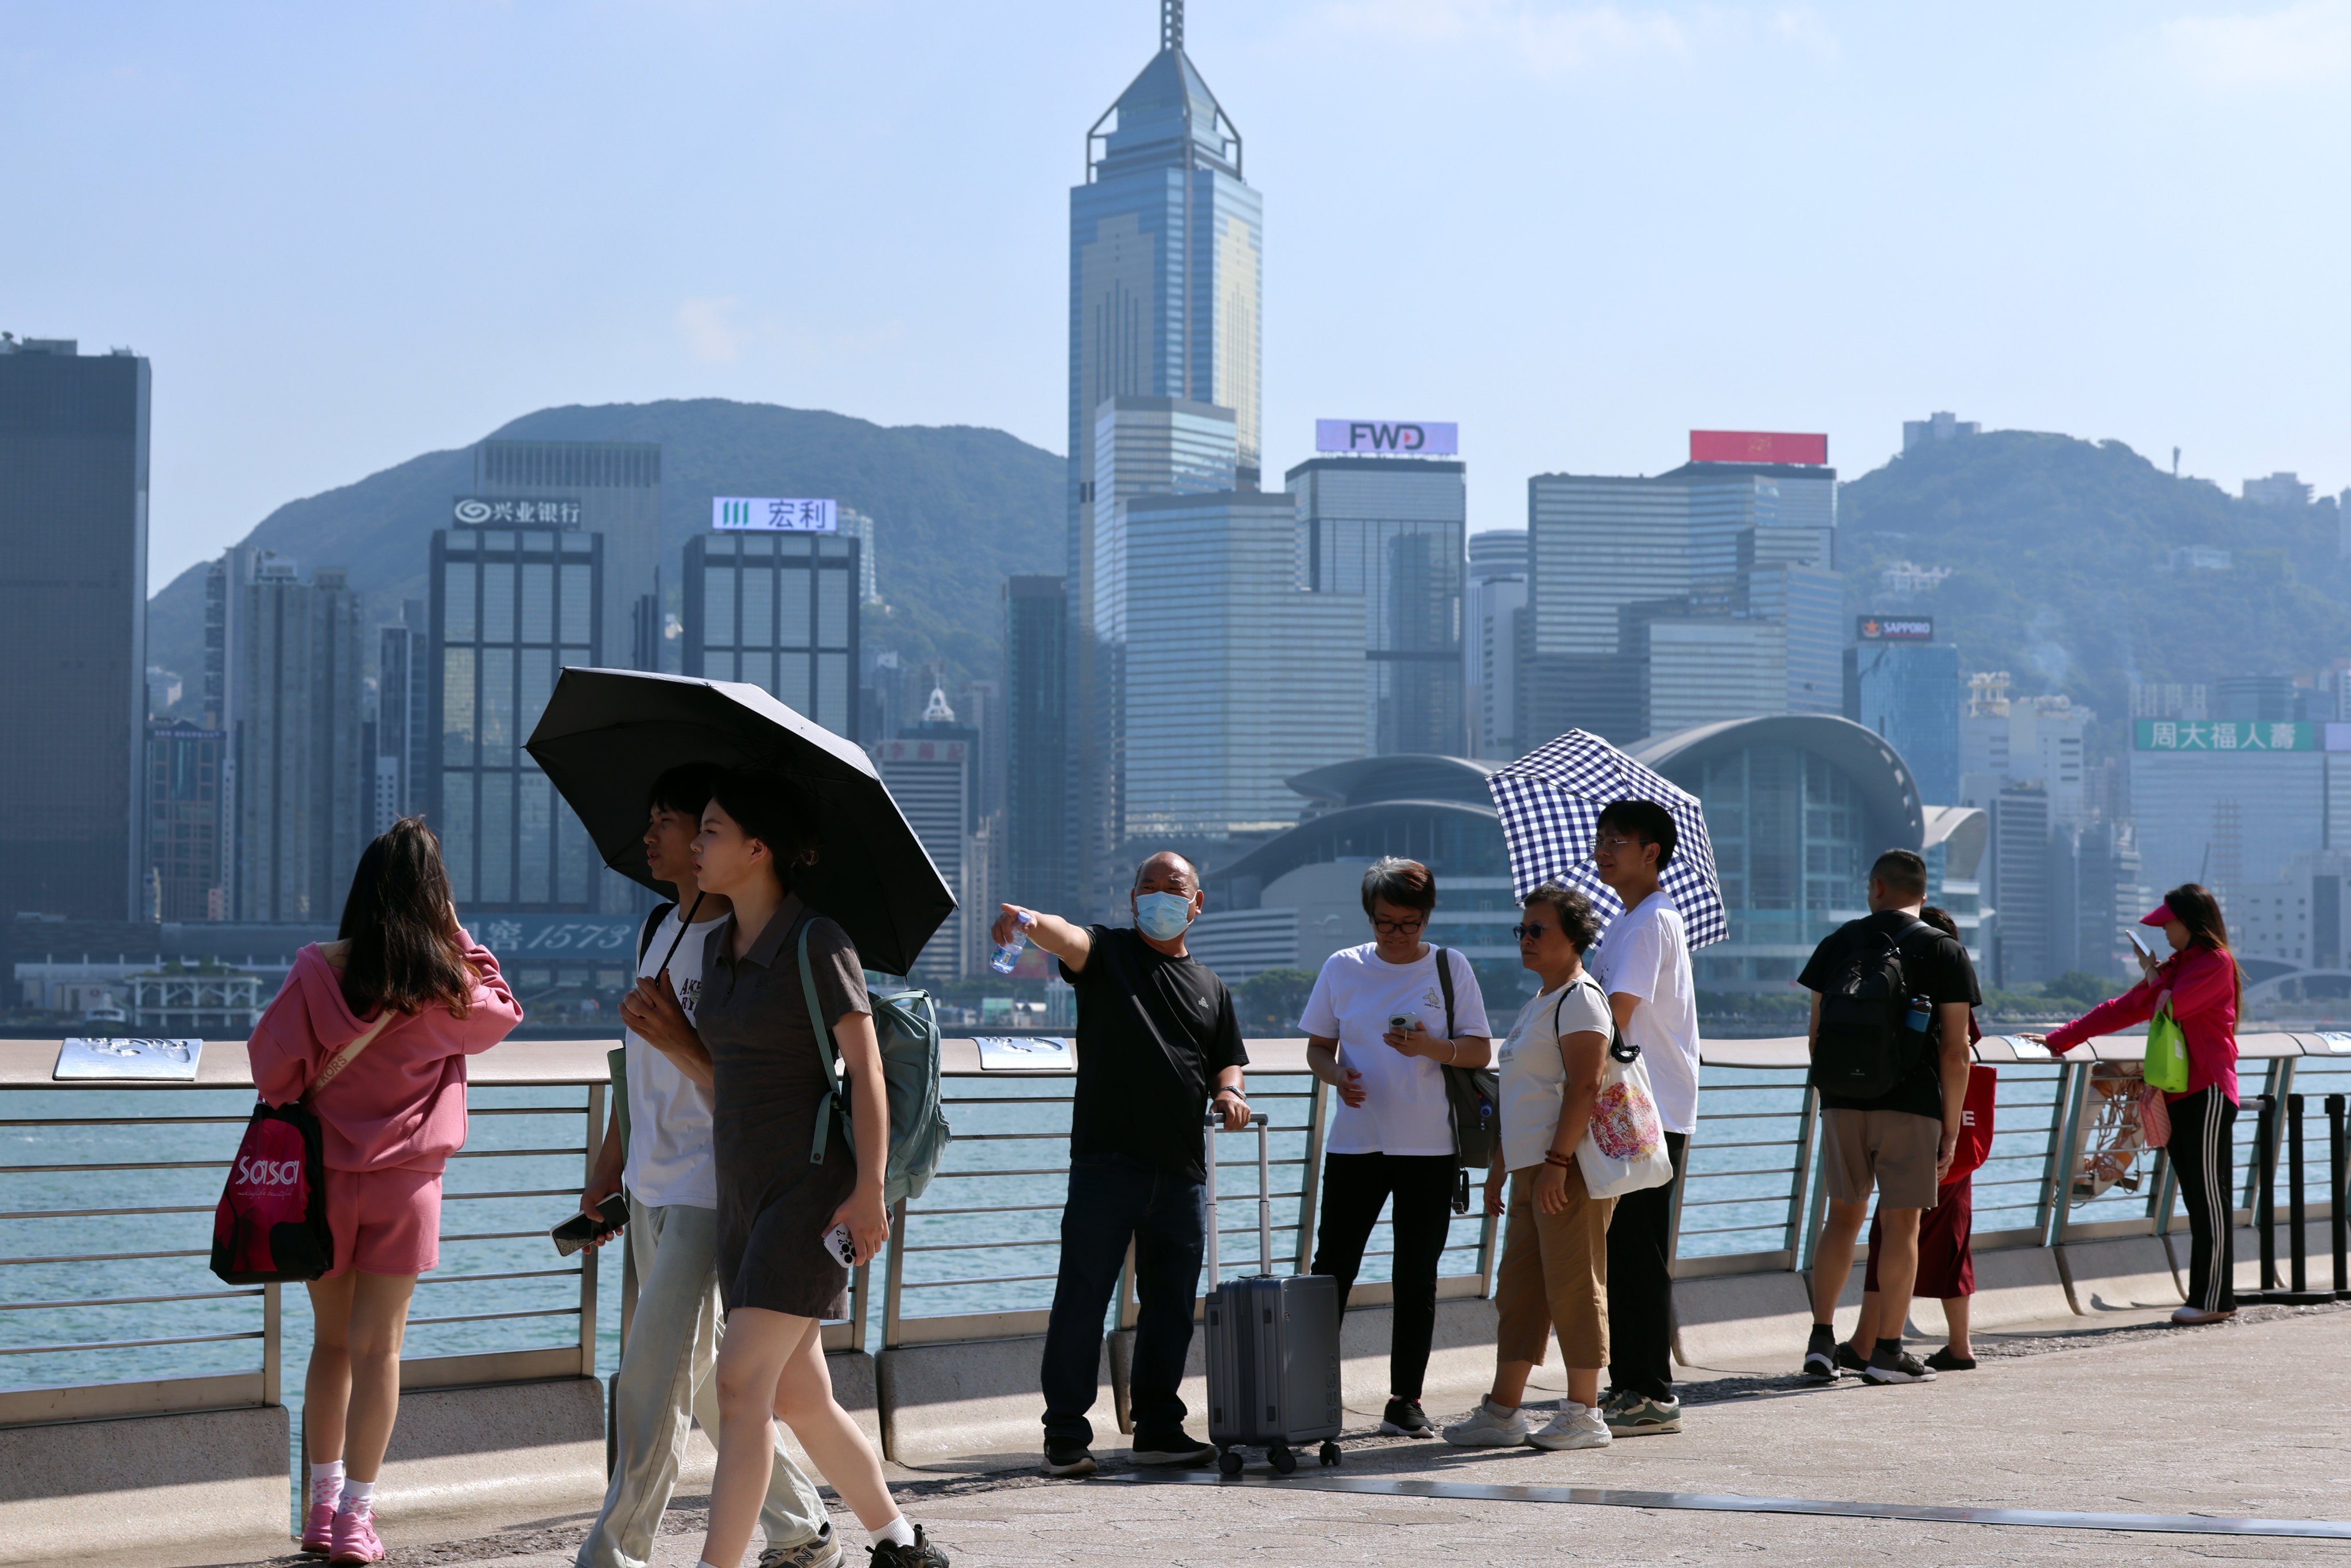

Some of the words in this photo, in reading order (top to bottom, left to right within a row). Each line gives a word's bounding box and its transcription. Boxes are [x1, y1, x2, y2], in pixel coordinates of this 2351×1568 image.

[1350, 423, 1425, 449] FWD
[493, 501, 580, 523] 兴业银行
[769, 499, 825, 529] 宏利
[1883, 622, 1930, 634] SAPPORO
[2151, 721, 2296, 748] 周大福人壽
[320, 1055, 347, 1083] KORS
